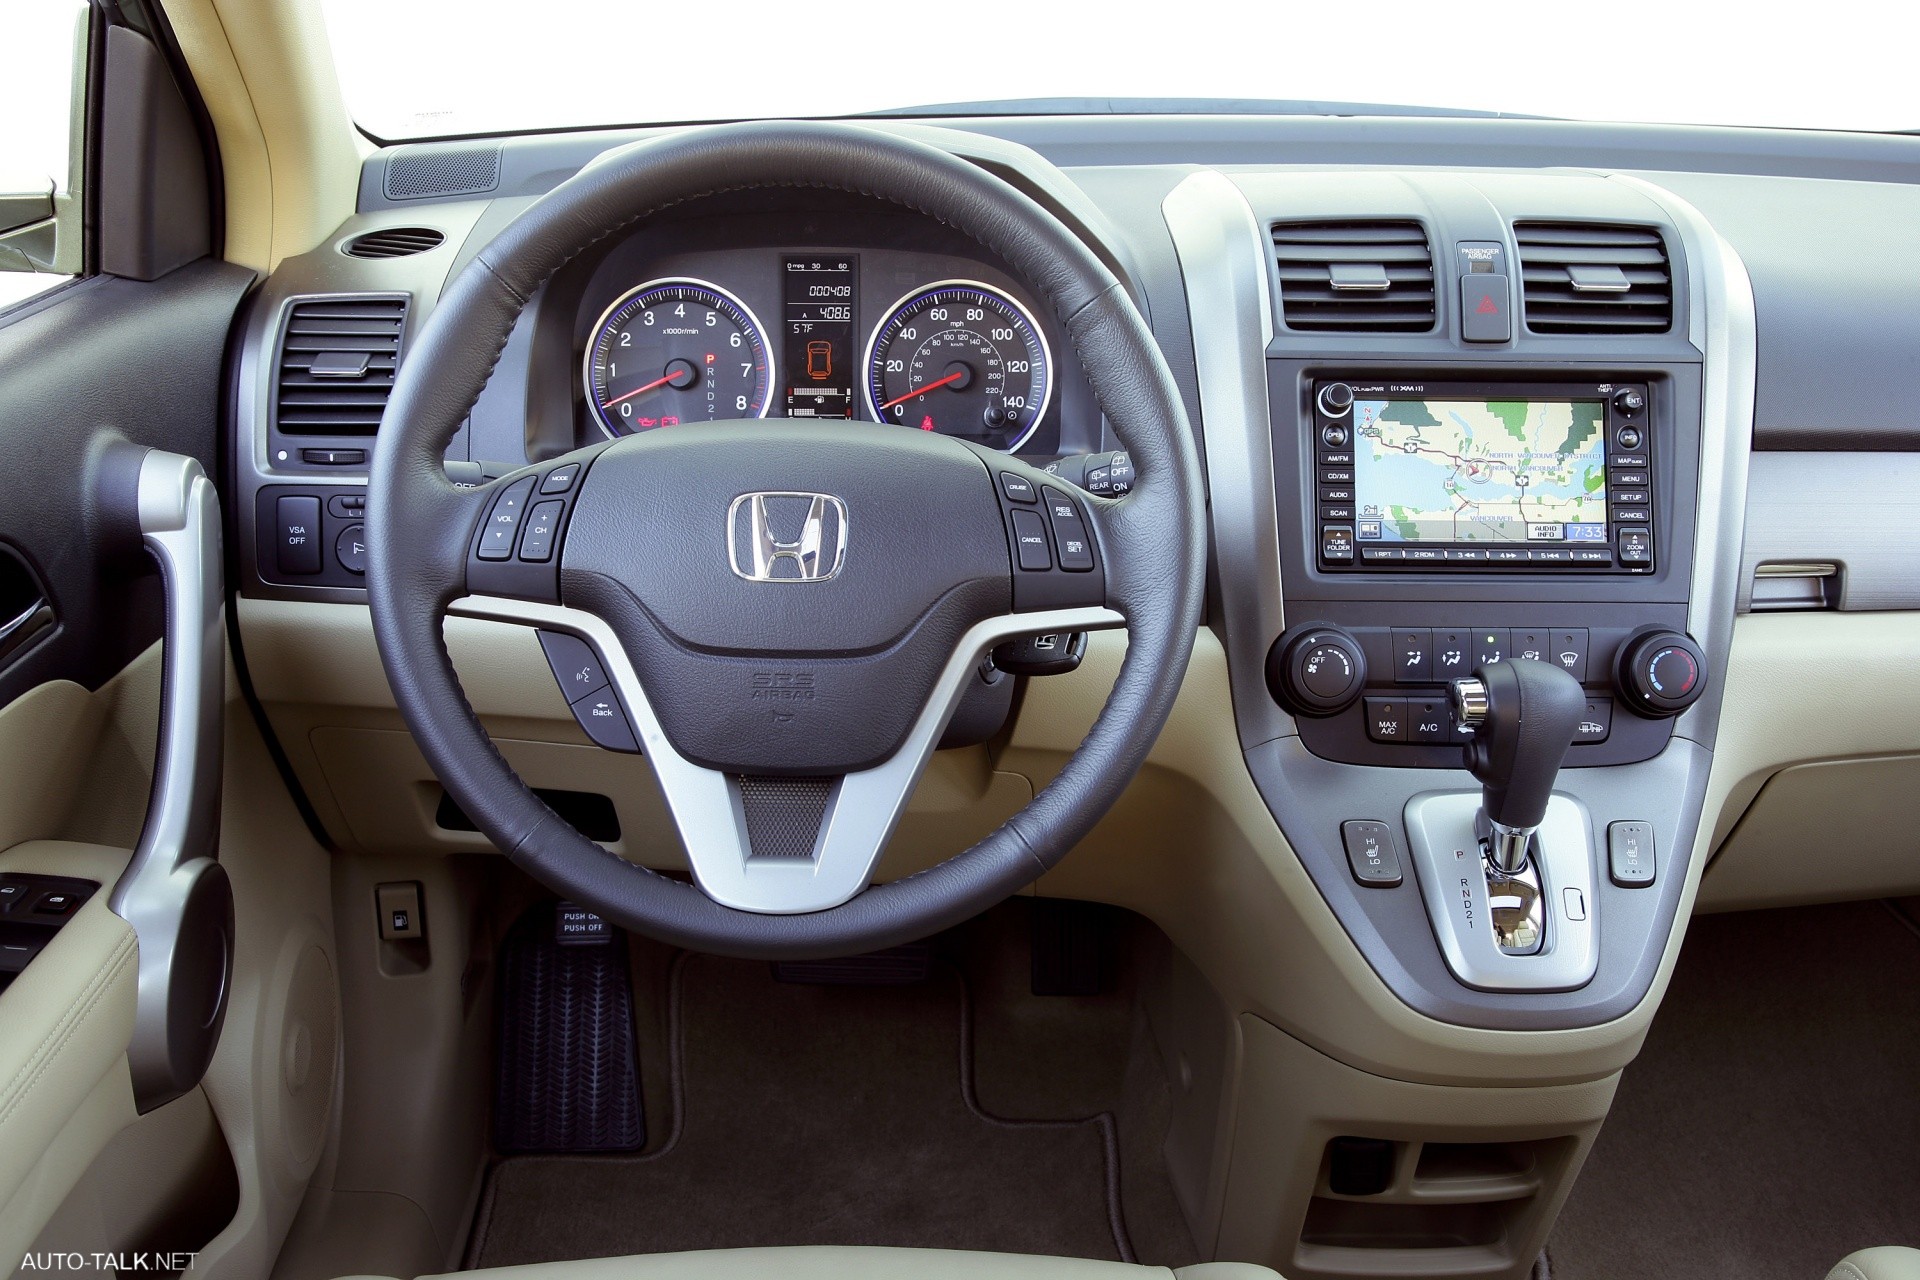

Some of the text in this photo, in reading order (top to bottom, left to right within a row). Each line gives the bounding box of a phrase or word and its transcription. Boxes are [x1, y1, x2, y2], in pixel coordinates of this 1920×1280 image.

[675, 304, 685, 318] 4
[930, 309, 948, 321] 60
[966, 309, 984, 321] 80
[644, 312, 654, 326] 3
[705, 312, 717, 326] 5
[620, 333, 631, 347] 2
[730, 333, 741, 347] 6
[900, 328, 916, 340] 40
[992, 328, 1013, 340] 100
[707, 354, 715, 364] P
[610, 364, 616, 377] 1
[708, 368, 714, 376] R
[741, 363, 752, 377] 7
[886, 360, 903, 372] 20
[1006, 361, 1028, 373] 120
[708, 380, 714, 388] N
[708, 392, 714, 400] D
[1002, 396, 1024, 408] 140
[736, 396, 747, 410] 8
[621, 403, 632, 417] 0
[894, 404, 904, 416] 0
[1111, 467, 1129, 476] OFF
[1090, 482, 1109, 490] REAR
[1113, 482, 1128, 491] ON
[1572, 527, 1602, 538] 7:33
[752, 673, 815, 686] SRS
[752, 690, 816, 700] AIRBAG
[1419, 724, 1438, 732] A/C
[1461, 879, 1468, 887] R
[1464, 901, 1472, 909] D
